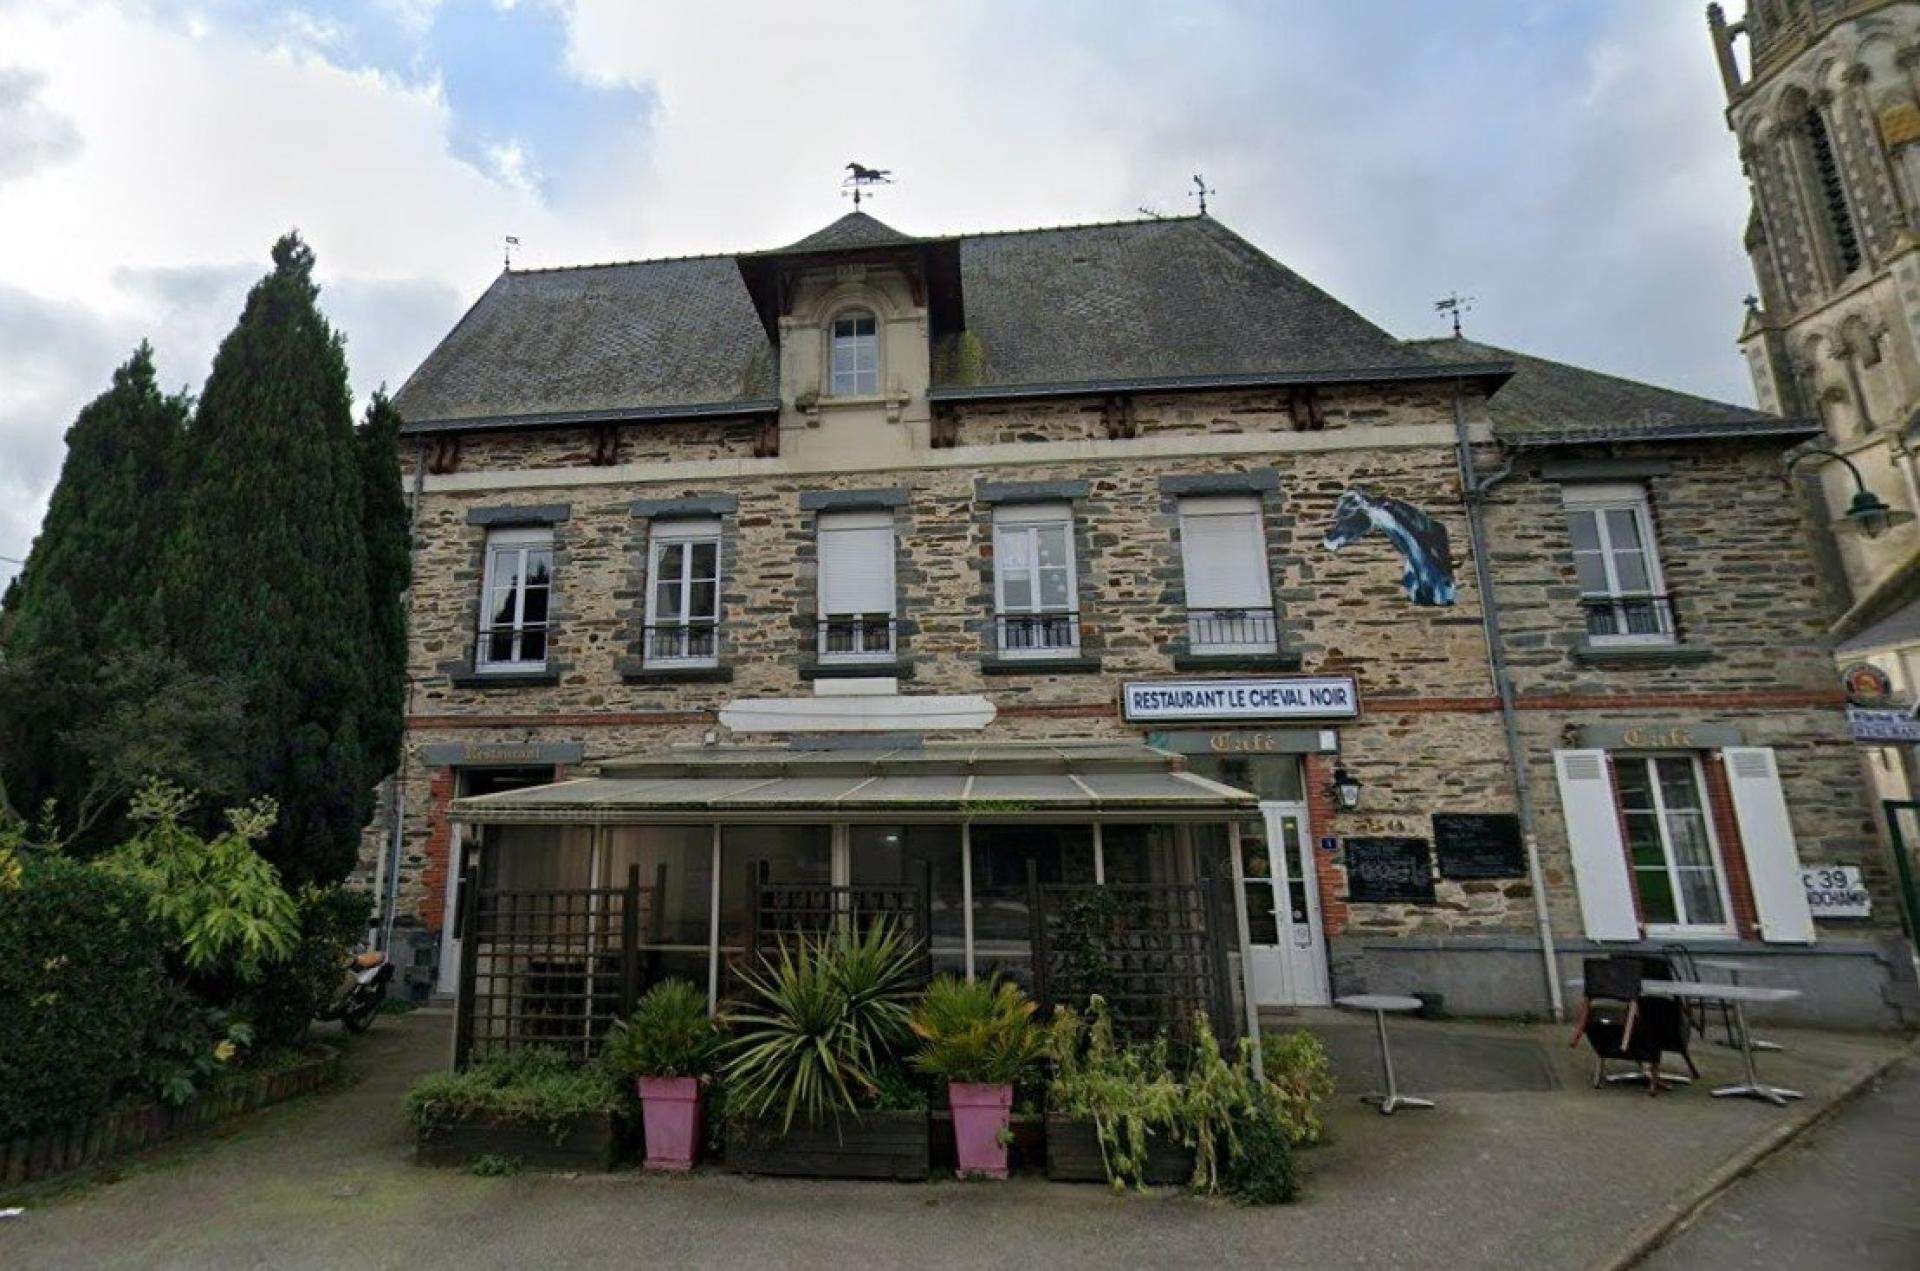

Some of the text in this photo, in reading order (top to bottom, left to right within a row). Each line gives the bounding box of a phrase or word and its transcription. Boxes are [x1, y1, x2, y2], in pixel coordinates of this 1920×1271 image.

[1133, 687, 1347, 710] RESTAURANT LE CHEVAL NOIR
[1209, 734, 1274, 751] Café
[1818, 870, 1848, 888] 39
